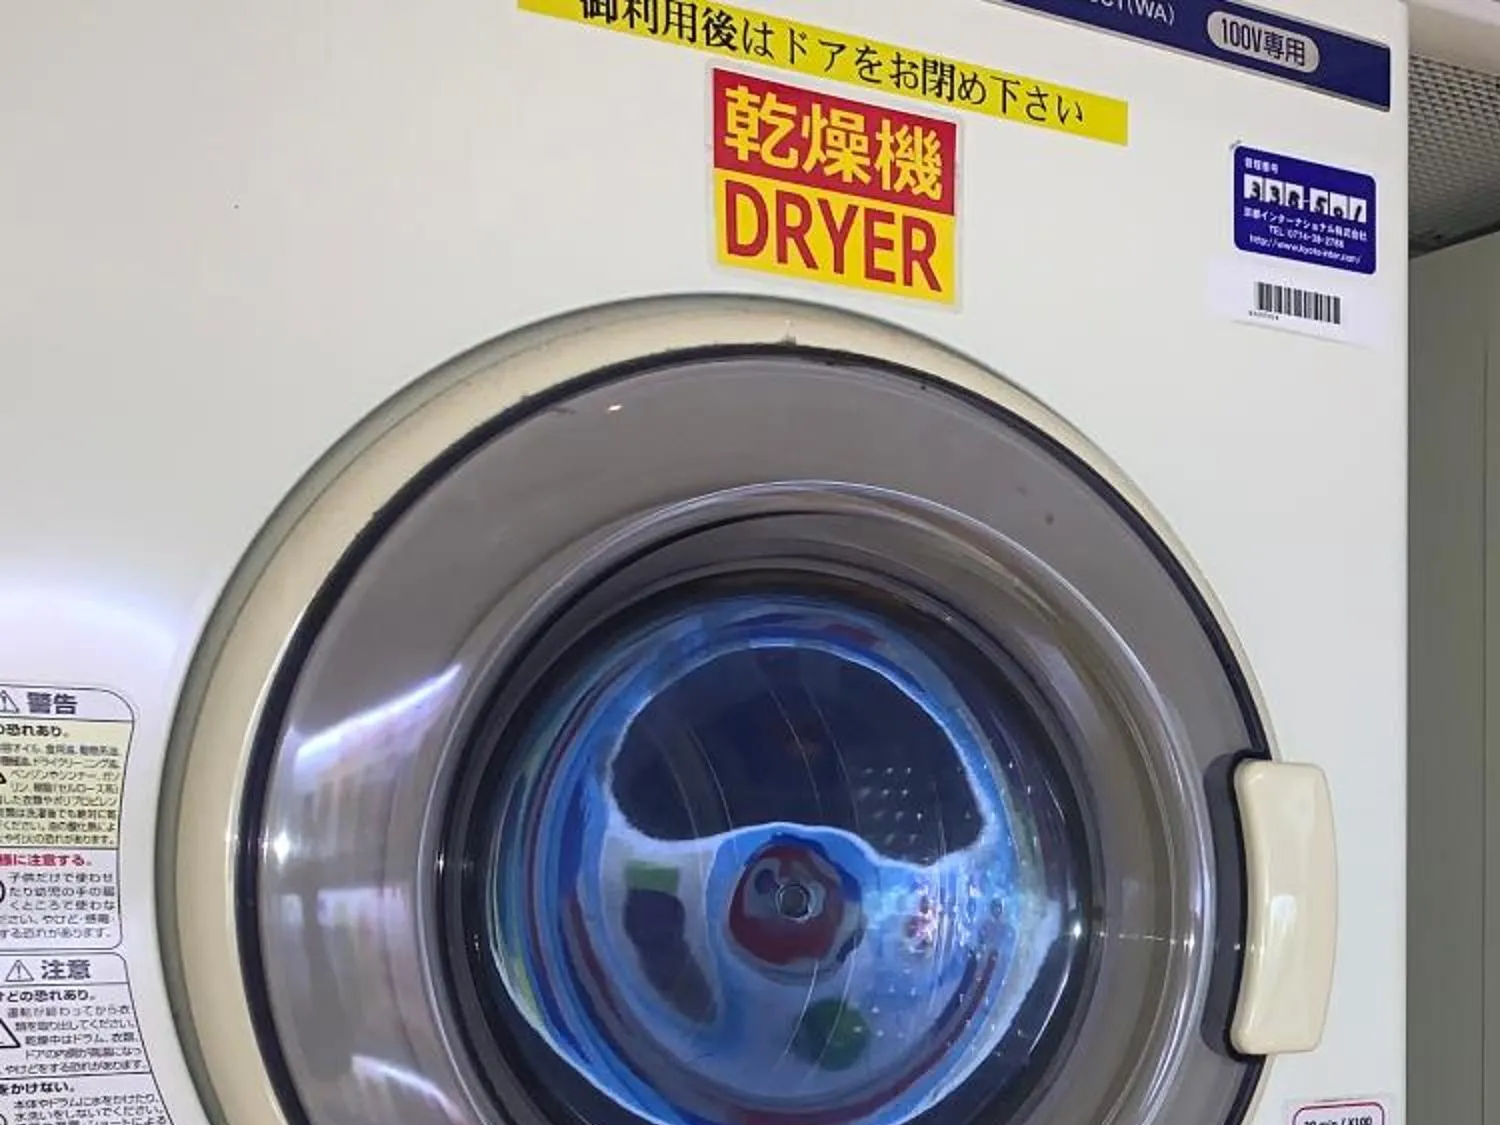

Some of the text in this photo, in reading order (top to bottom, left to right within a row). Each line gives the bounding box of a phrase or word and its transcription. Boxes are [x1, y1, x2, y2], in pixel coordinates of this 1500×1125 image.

[1220, 17, 1306, 66] 100V専用
[725, 85, 943, 201] 乾燥機
[725, 179, 942, 293] DRYER
[28, 692, 77, 714] 警告
[41, 959, 91, 980] 注意
